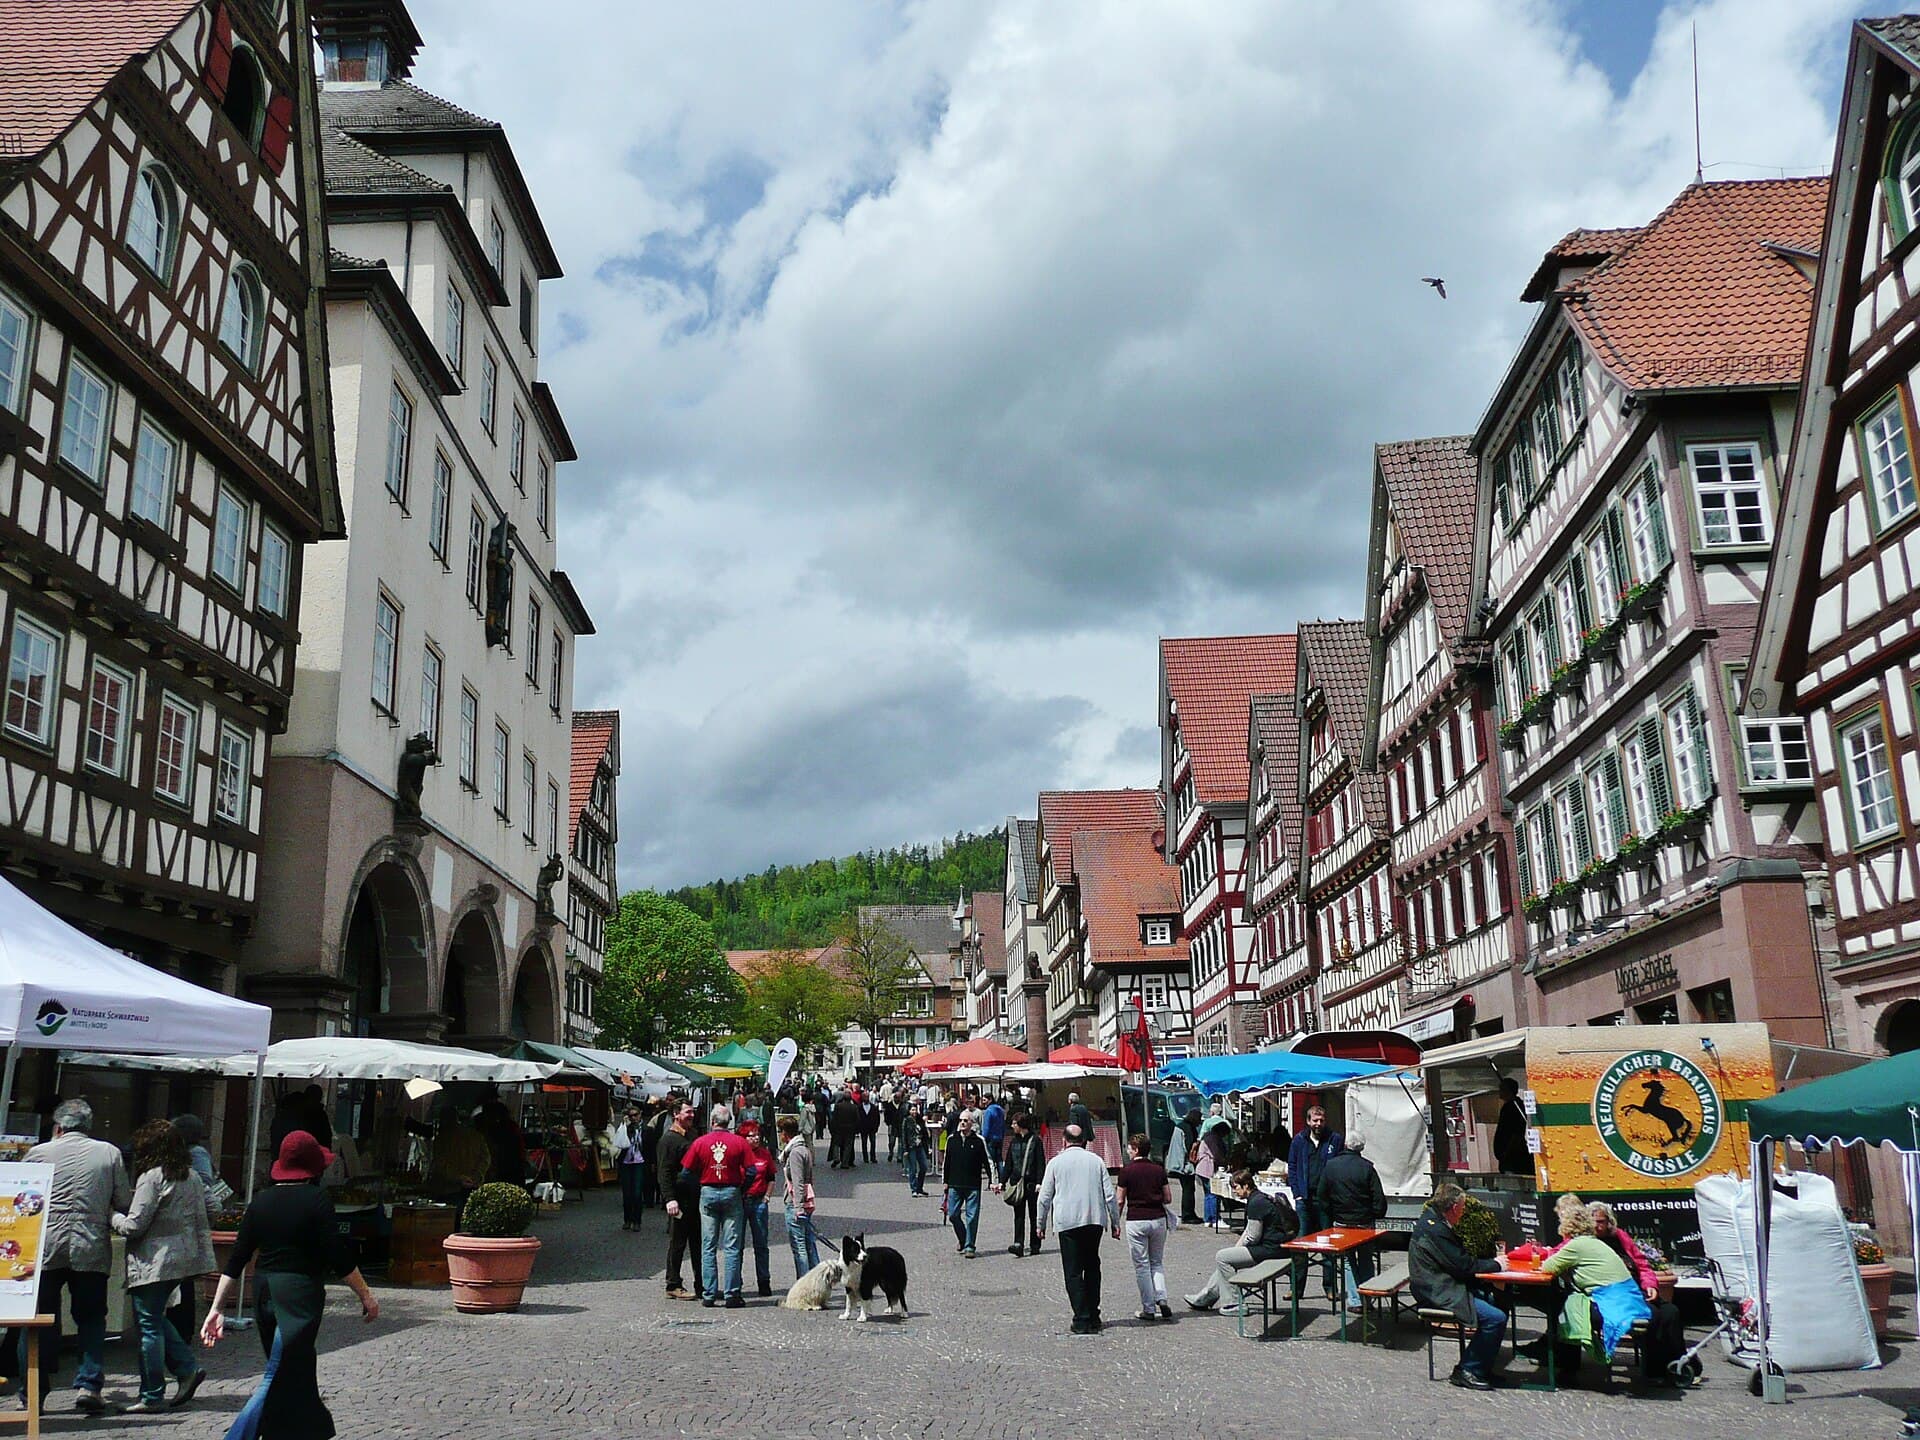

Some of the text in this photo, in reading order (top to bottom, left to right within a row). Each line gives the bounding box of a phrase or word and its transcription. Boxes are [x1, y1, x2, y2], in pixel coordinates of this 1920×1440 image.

[1306, 1013, 1314, 1033] HOT
[1600, 1054, 1716, 1137] NEUBULACHER BRAUHAUS
[1627, 1149, 1699, 1173] RÖSSLE
